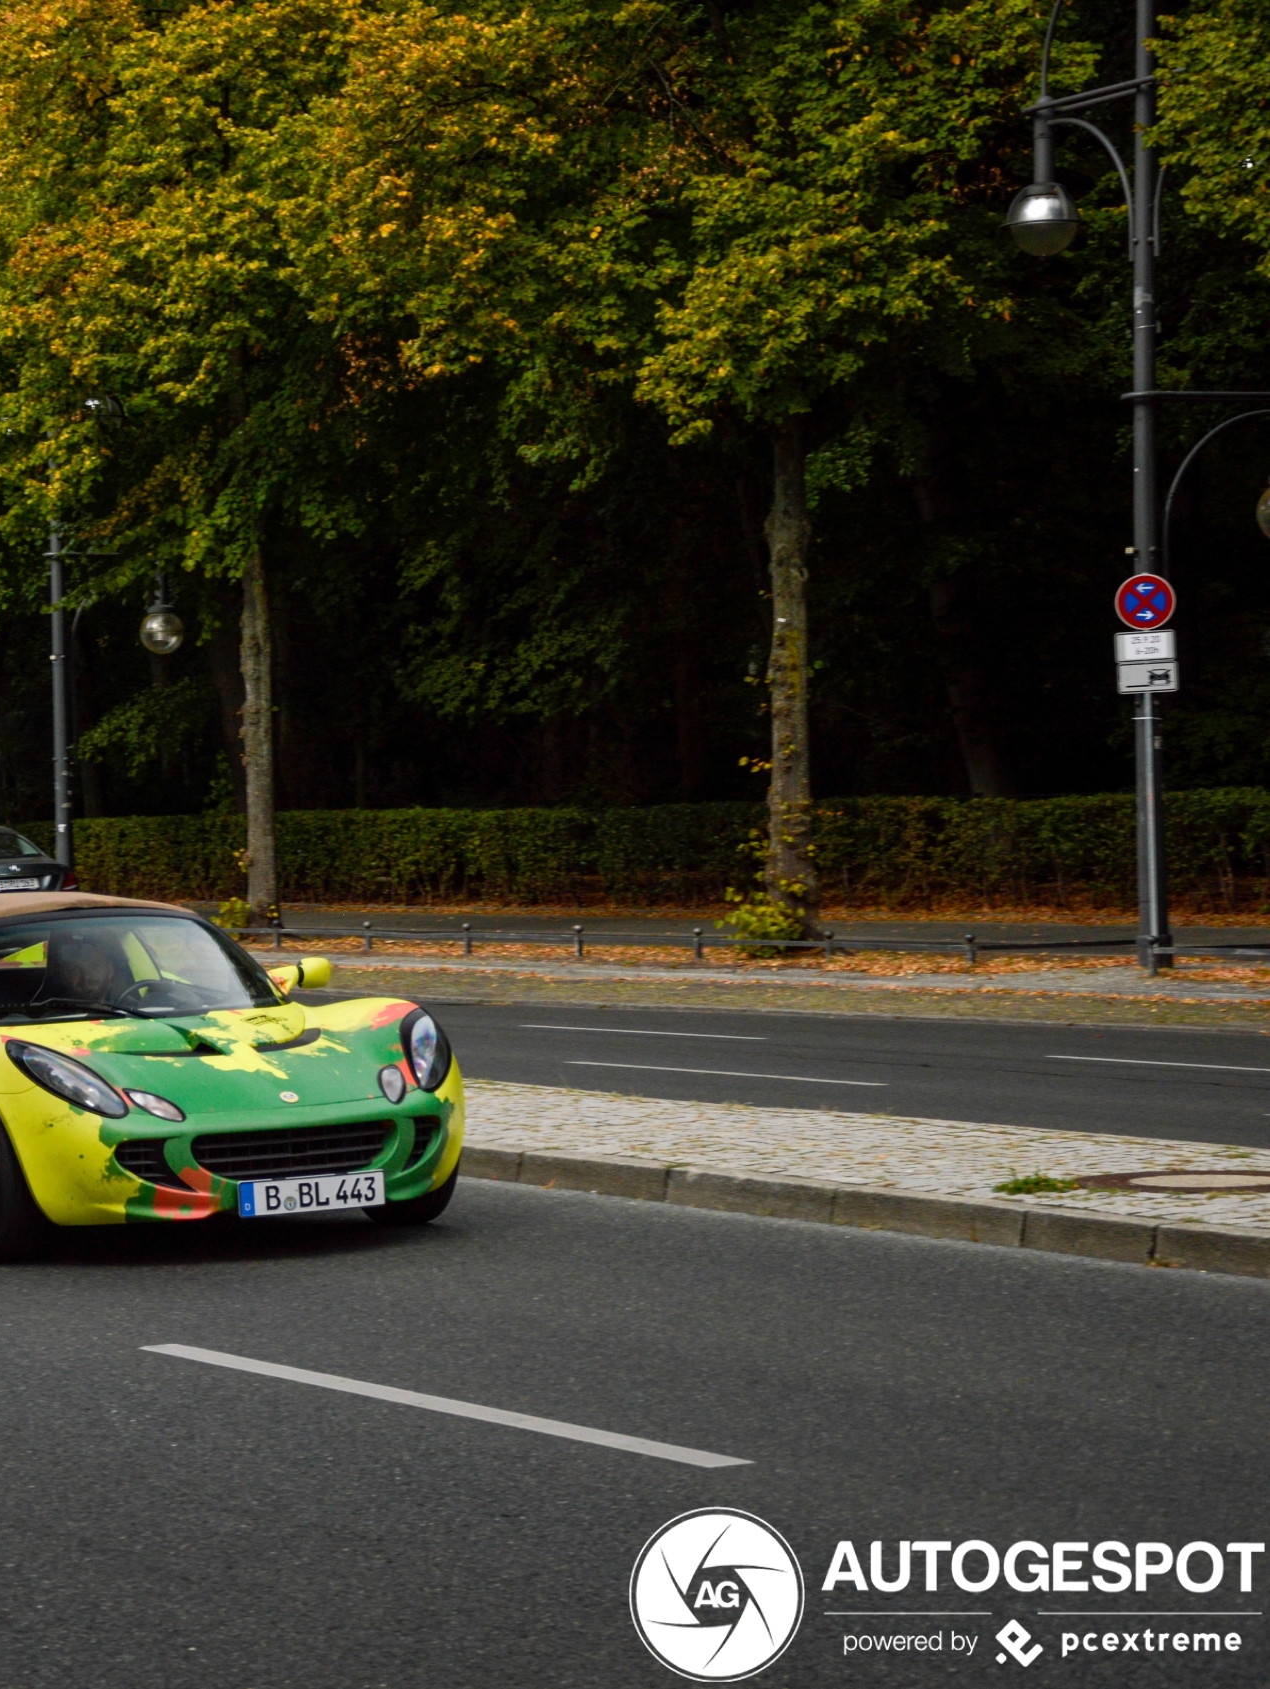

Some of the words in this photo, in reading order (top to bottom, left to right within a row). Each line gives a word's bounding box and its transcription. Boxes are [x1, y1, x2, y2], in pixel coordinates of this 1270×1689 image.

[265, 1185, 281, 1211] B
[298, 1181, 330, 1209] BL
[336, 1176, 376, 1205] 443
[245, 1202, 251, 1211] D
